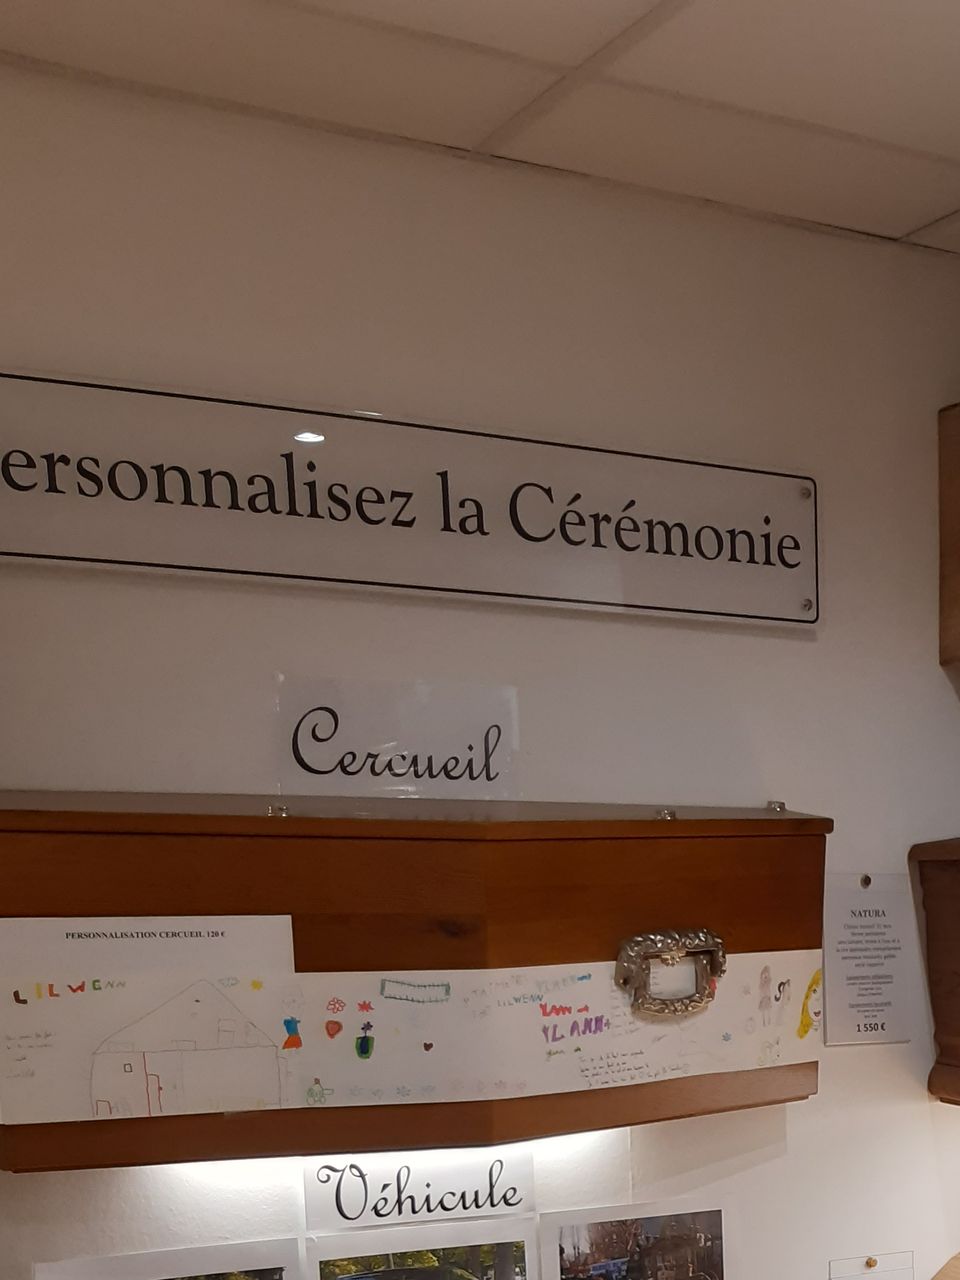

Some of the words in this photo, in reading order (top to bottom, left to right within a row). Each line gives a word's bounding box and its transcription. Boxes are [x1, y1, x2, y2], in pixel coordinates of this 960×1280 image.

[0, 449, 416, 528] ersonnalisez
[437, 471, 490, 537] la
[508, 480, 802, 570] Cérémonie
[290, 705, 503, 783] Cercueil
[850, 909, 887, 918] NATURA
[65, 931, 157, 940] PERSONNALISATION
[158, 930, 204, 939] CERCUEIL
[207, 930, 220, 938] 120
[221, 930, 227, 938] €
[856, 1023, 862, 1033] 1
[863, 1022, 879, 1033] 550
[880, 1021, 887, 1032] €
[316, 1158, 524, 1221] Véhicule
